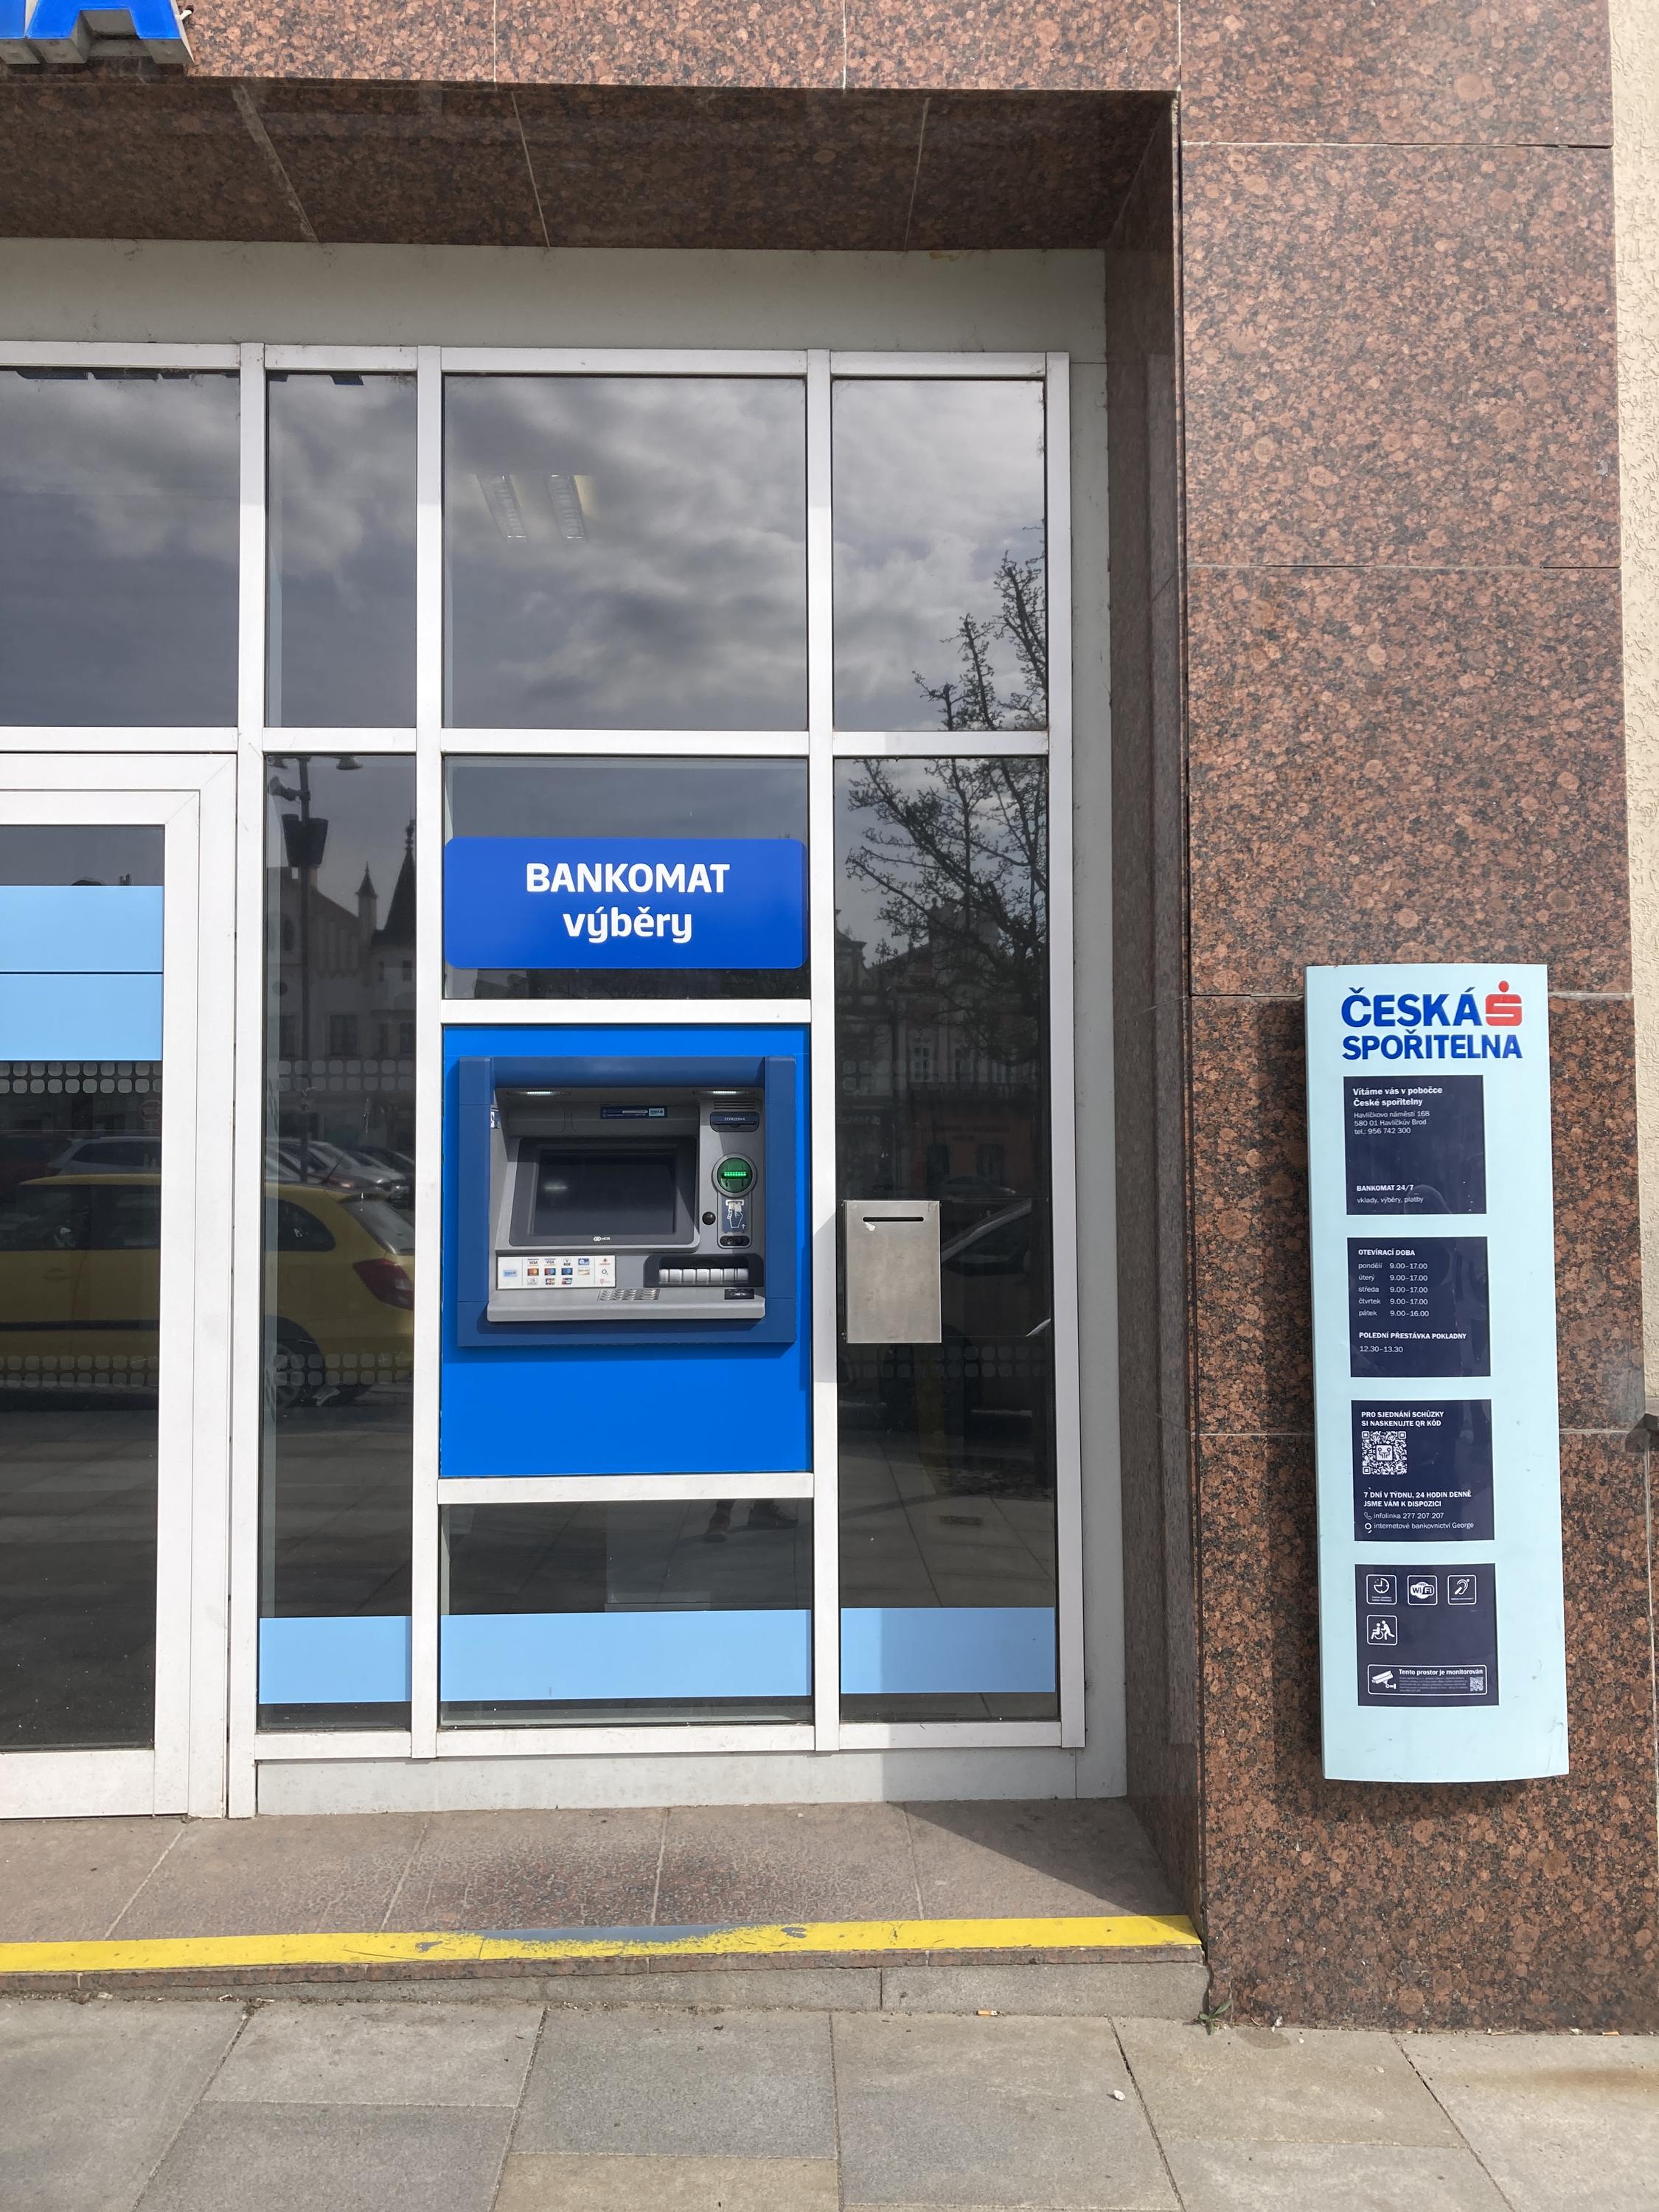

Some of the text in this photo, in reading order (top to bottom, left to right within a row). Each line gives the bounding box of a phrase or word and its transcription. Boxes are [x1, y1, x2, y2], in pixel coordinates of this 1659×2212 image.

[526, 863, 730, 893] BANKOMAT
[563, 907, 692, 943] výběry
[1341, 987, 1483, 1027] ČESKÁ
[1342, 1029, 1523, 1060] SPOŘITELNA
[1354, 1098, 1423, 1107] České spořitelny
[1408, 1086, 1442, 1095] pobočce
[1449, 1489, 1472, 1498] DENNĚ
